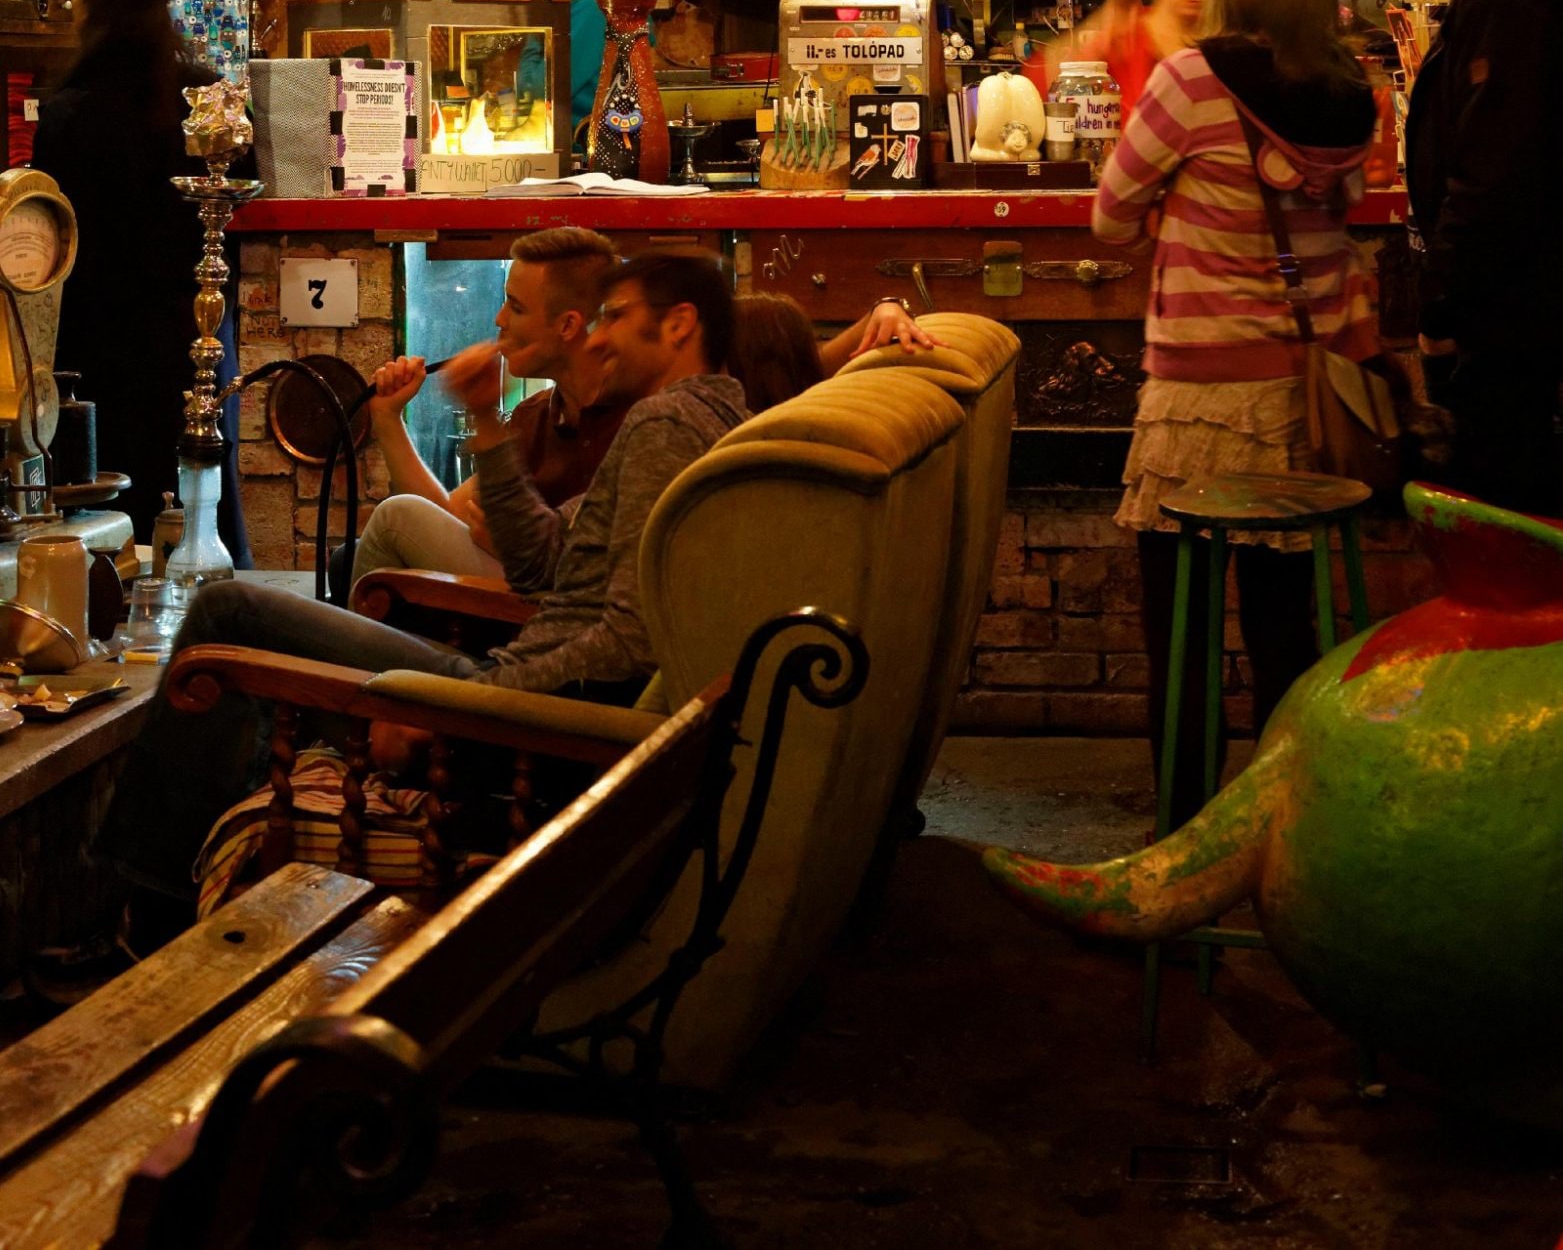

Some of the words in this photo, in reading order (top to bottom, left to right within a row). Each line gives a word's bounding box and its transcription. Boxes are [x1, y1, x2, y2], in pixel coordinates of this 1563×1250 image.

[842, 41, 905, 59] TOLÓPAD
[343, 82, 384, 93] HOMELESSNESS
[356, 94, 370, 104] STOP
[308, 279, 327, 309] 7
